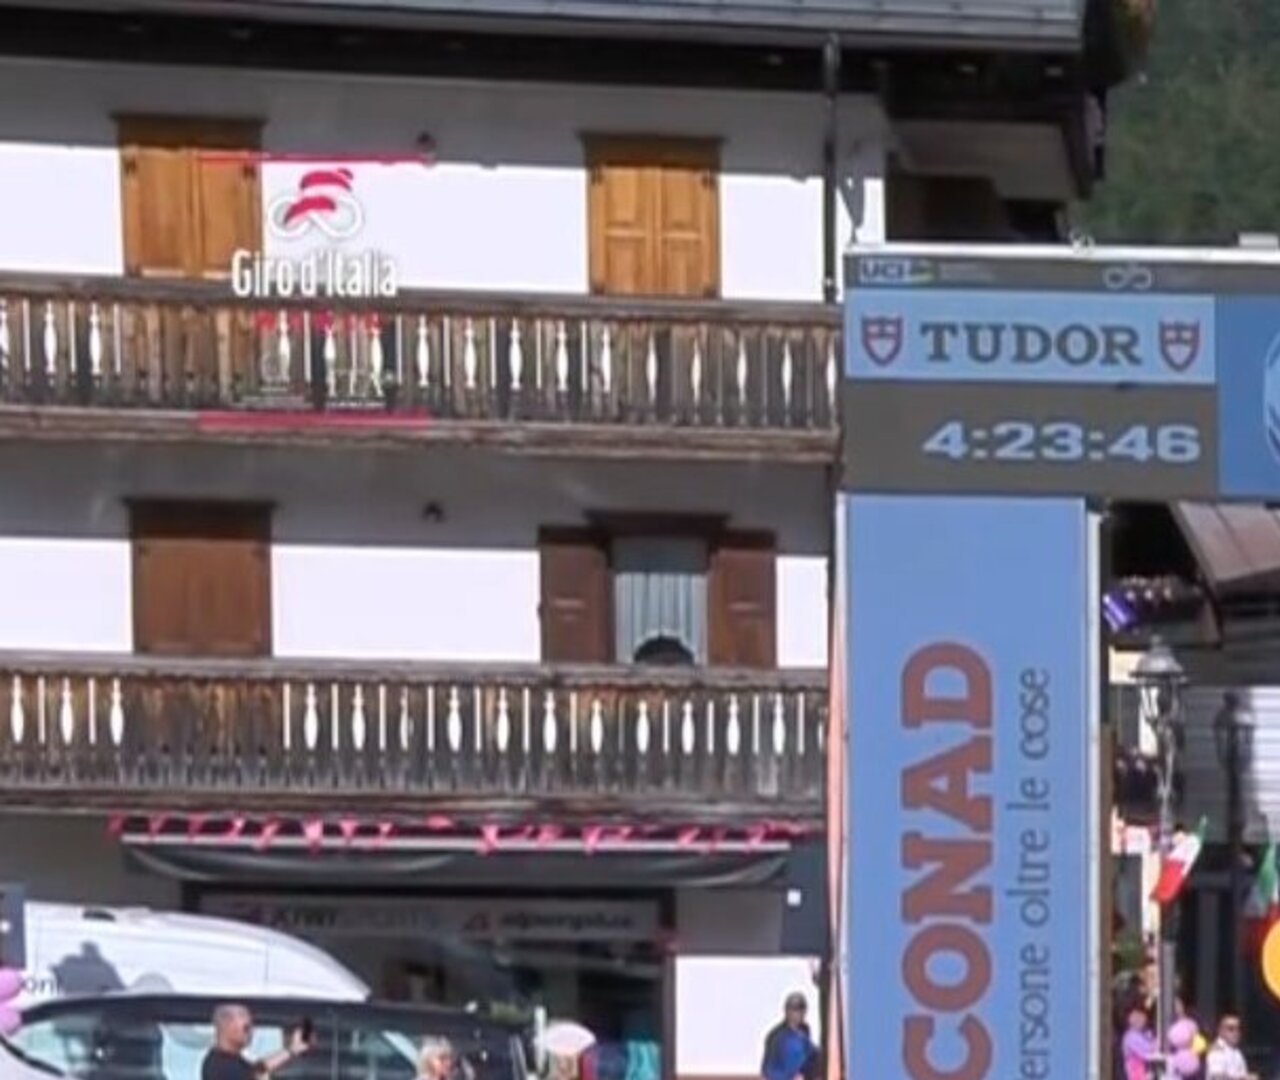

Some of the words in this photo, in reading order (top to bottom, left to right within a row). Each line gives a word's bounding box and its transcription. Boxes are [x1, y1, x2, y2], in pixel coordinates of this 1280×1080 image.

[921, 323, 1142, 366] TUDOR
[923, 421, 1201, 461] 4:23:46
[1018, 667, 1051, 758] cose
[1007, 775, 1051, 812] le
[1007, 829, 1051, 927] oltre
